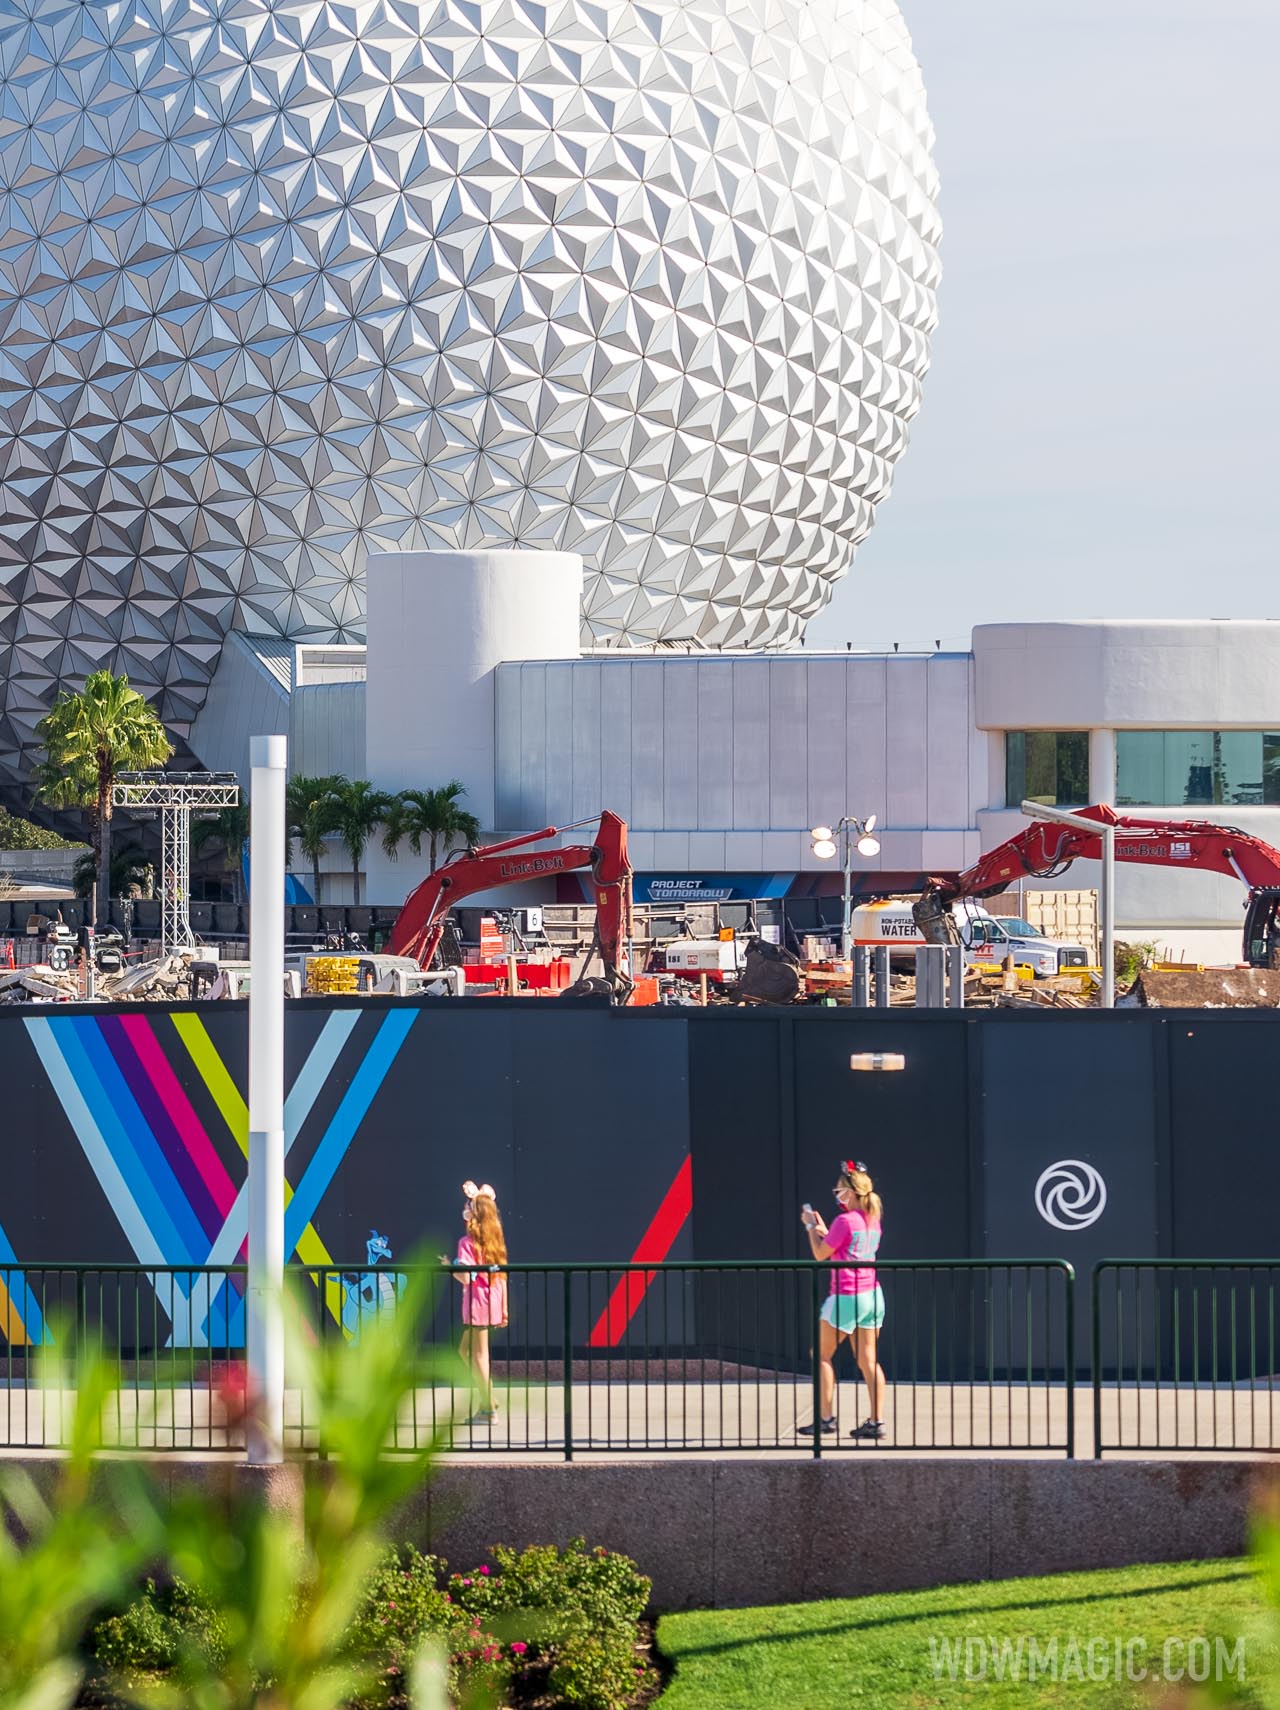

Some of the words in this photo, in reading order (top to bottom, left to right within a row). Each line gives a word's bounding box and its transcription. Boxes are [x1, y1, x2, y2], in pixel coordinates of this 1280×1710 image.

[651, 880, 703, 888] PROJECT
[655, 888, 724, 898] TOMORROW
[531, 914, 538, 927] 6
[881, 926, 917, 936] WATER
